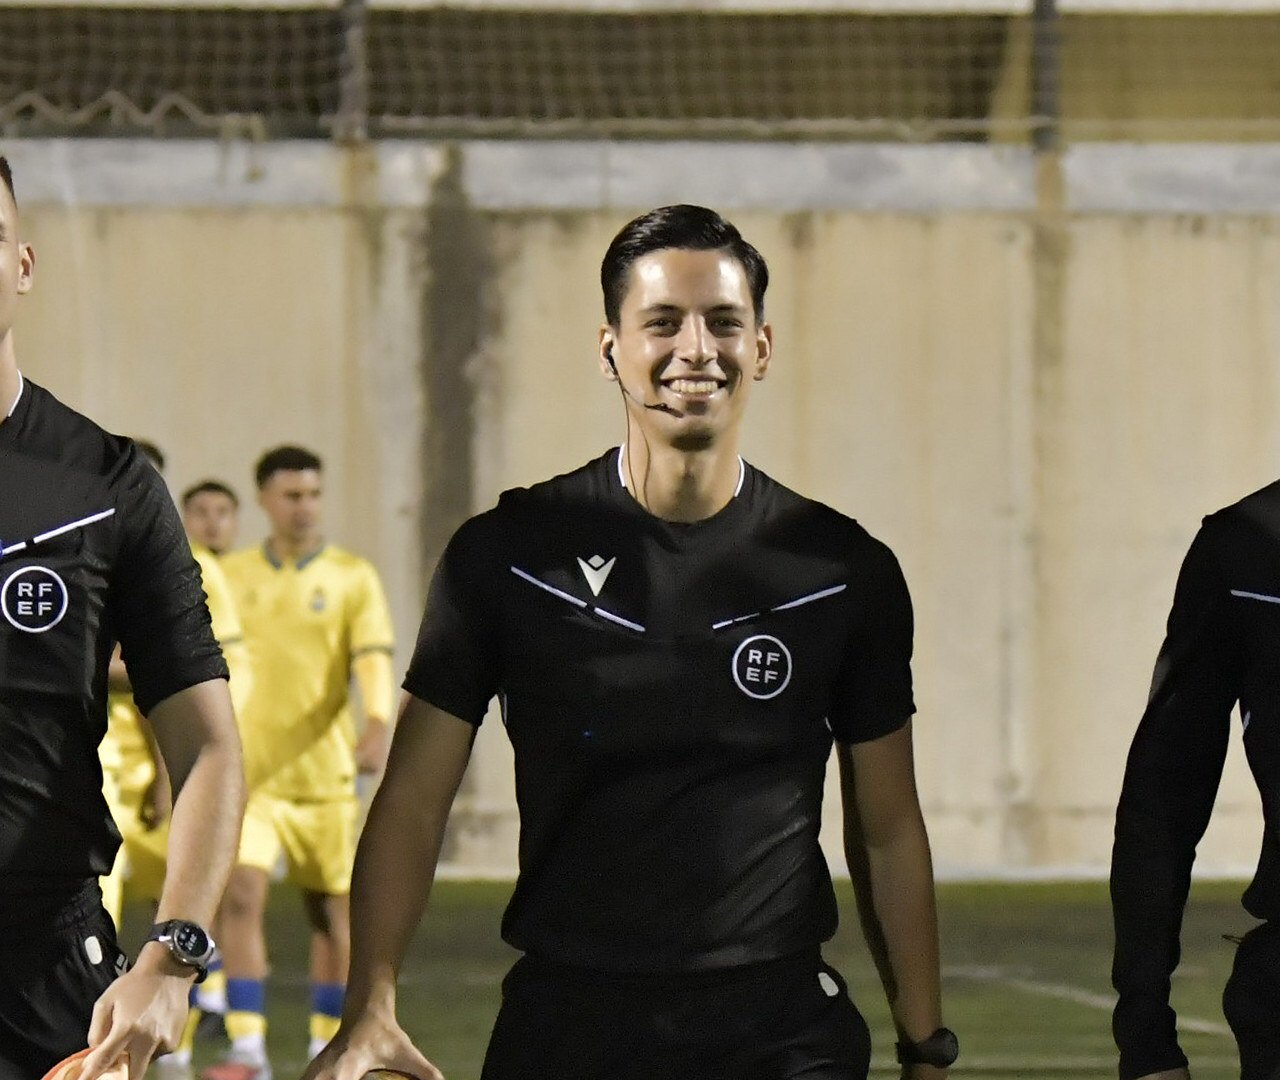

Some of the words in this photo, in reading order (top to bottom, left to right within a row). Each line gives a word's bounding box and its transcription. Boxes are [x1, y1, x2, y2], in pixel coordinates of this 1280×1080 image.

[17, 582, 53, 597] RF
[17, 601, 53, 616] EF
[748, 649, 780, 665] RF
[746, 667, 778, 683] EF
